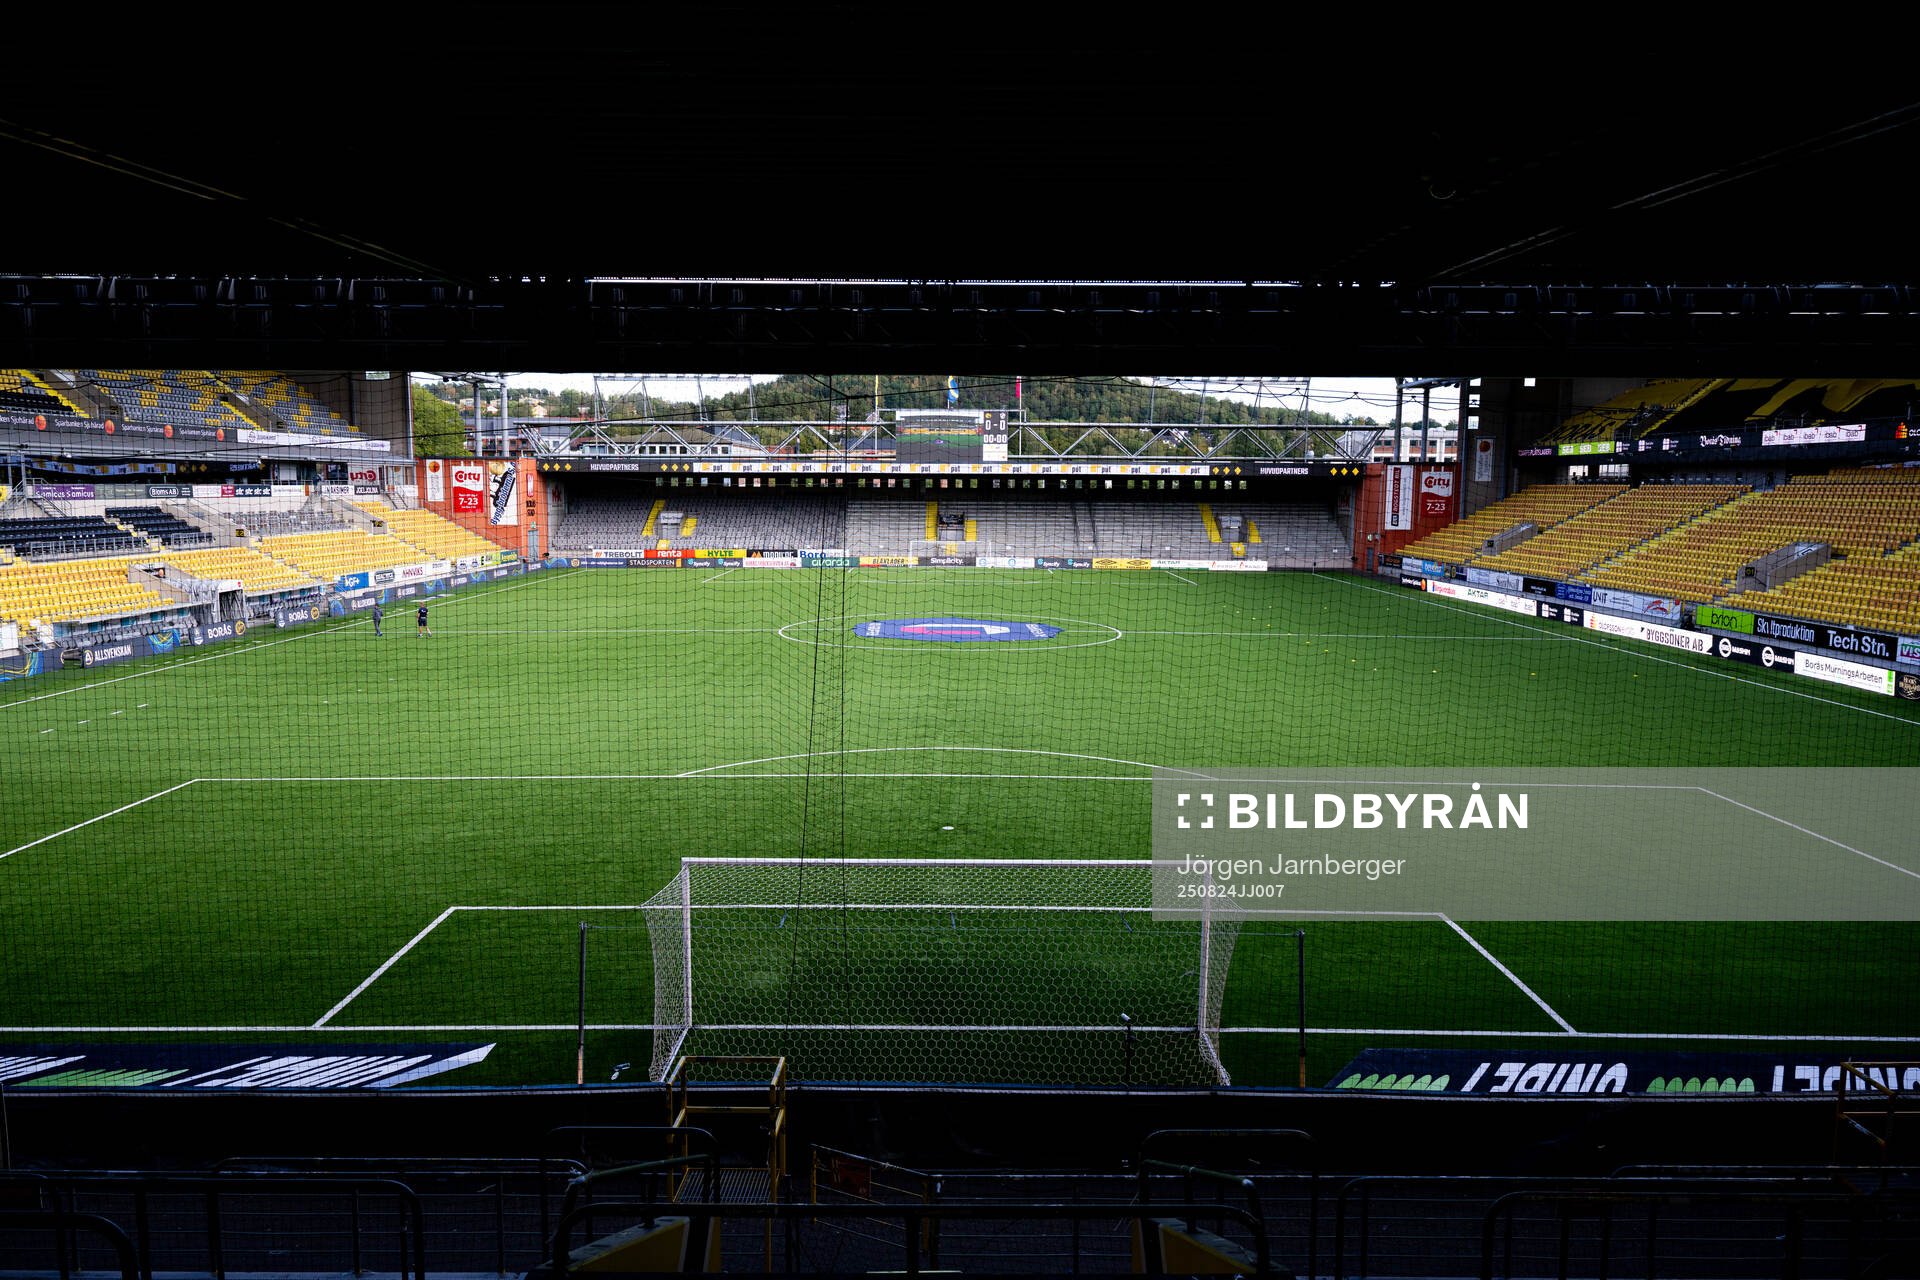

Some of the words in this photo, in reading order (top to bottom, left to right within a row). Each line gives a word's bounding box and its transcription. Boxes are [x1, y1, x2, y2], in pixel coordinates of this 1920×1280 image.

[986, 420, 991, 429] 0
[1000, 420, 1005, 429] 0
[455, 471, 480, 482] City
[1424, 477, 1449, 488] City
[1426, 503, 1446, 511] 7-23
[289, 609, 308, 622] BORÅS
[208, 624, 232, 638] BORÅS
[1692, 641, 1703, 655] AB
[1827, 630, 1859, 652] Tech
[1861, 636, 1889, 657] Stn.
